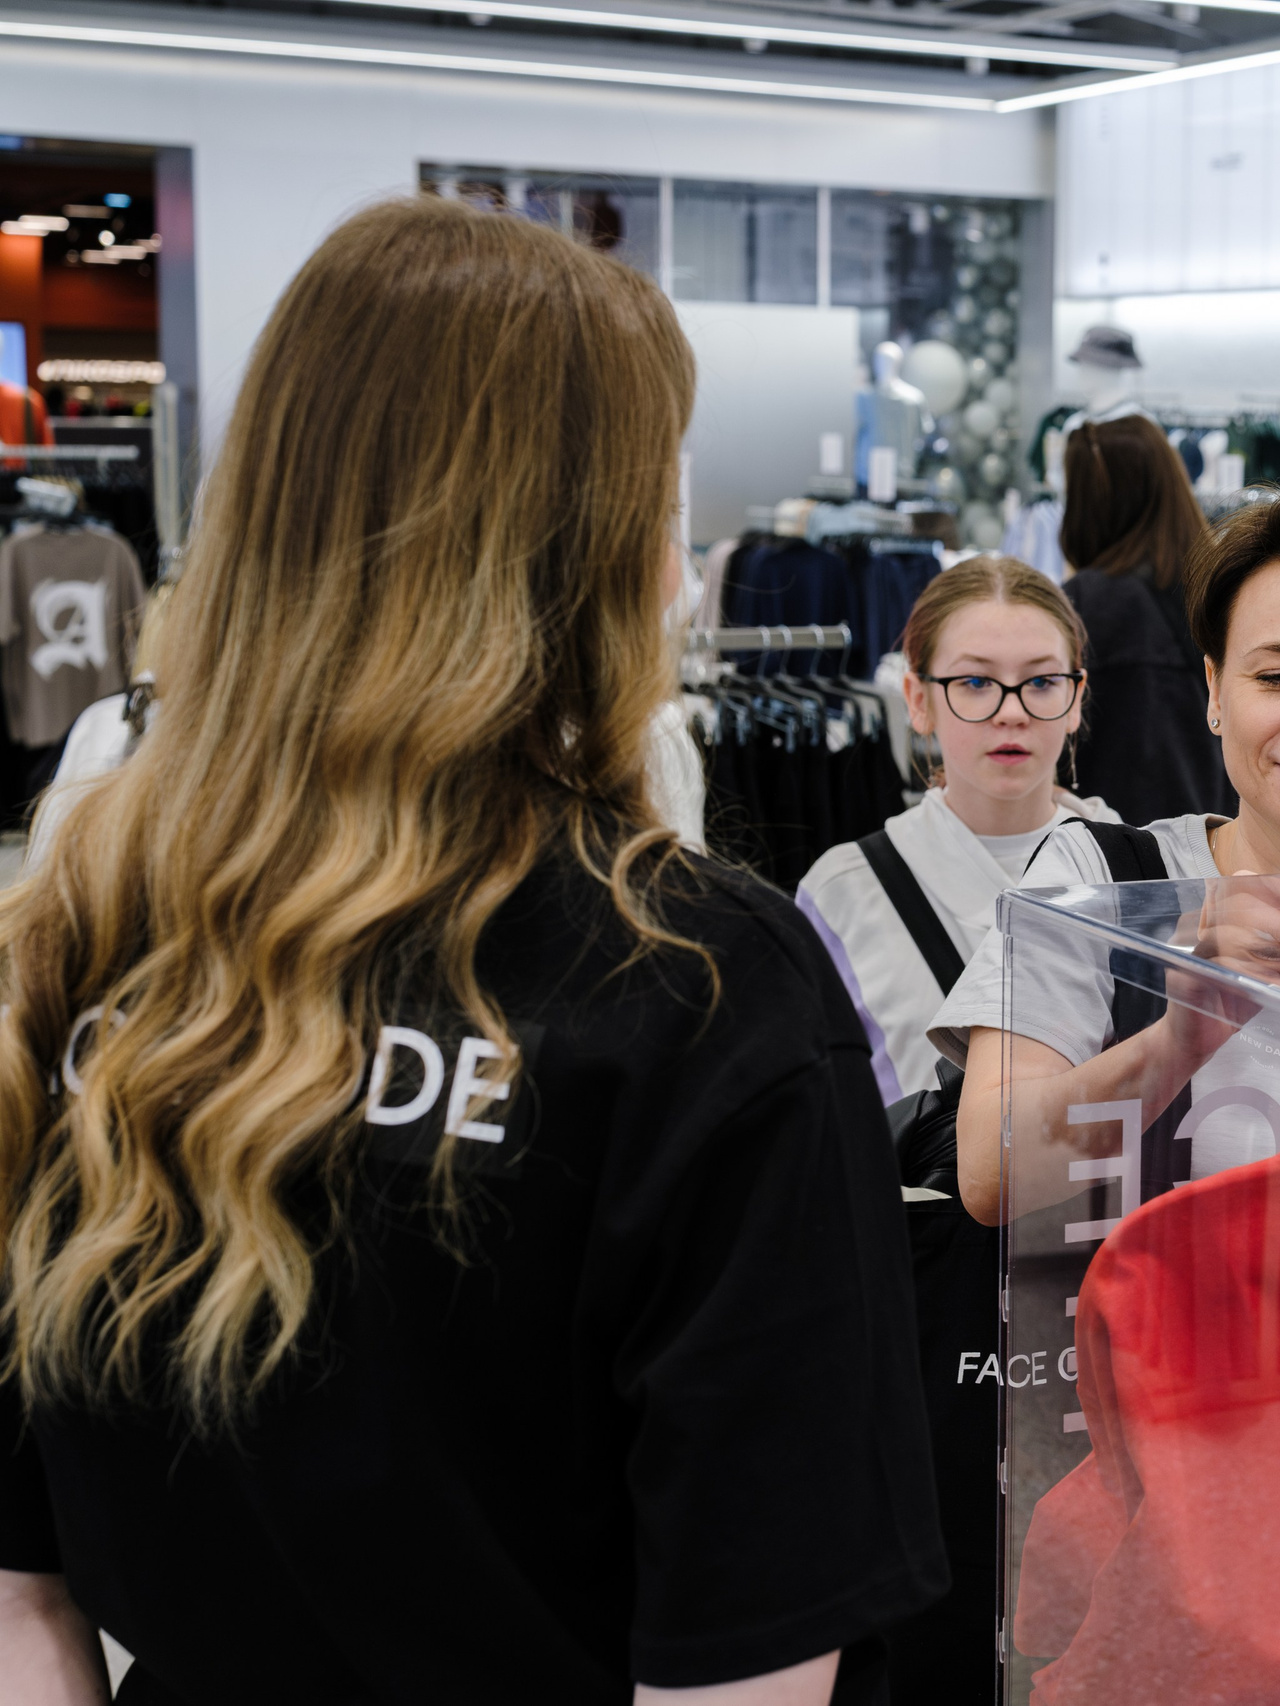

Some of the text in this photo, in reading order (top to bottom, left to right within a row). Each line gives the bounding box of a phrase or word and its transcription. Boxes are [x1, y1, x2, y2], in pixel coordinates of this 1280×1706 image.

[1240, 1032, 1262, 1049] NEW
[350, 1025, 520, 1143] DE
[957, 1351, 1047, 1388] FACE
